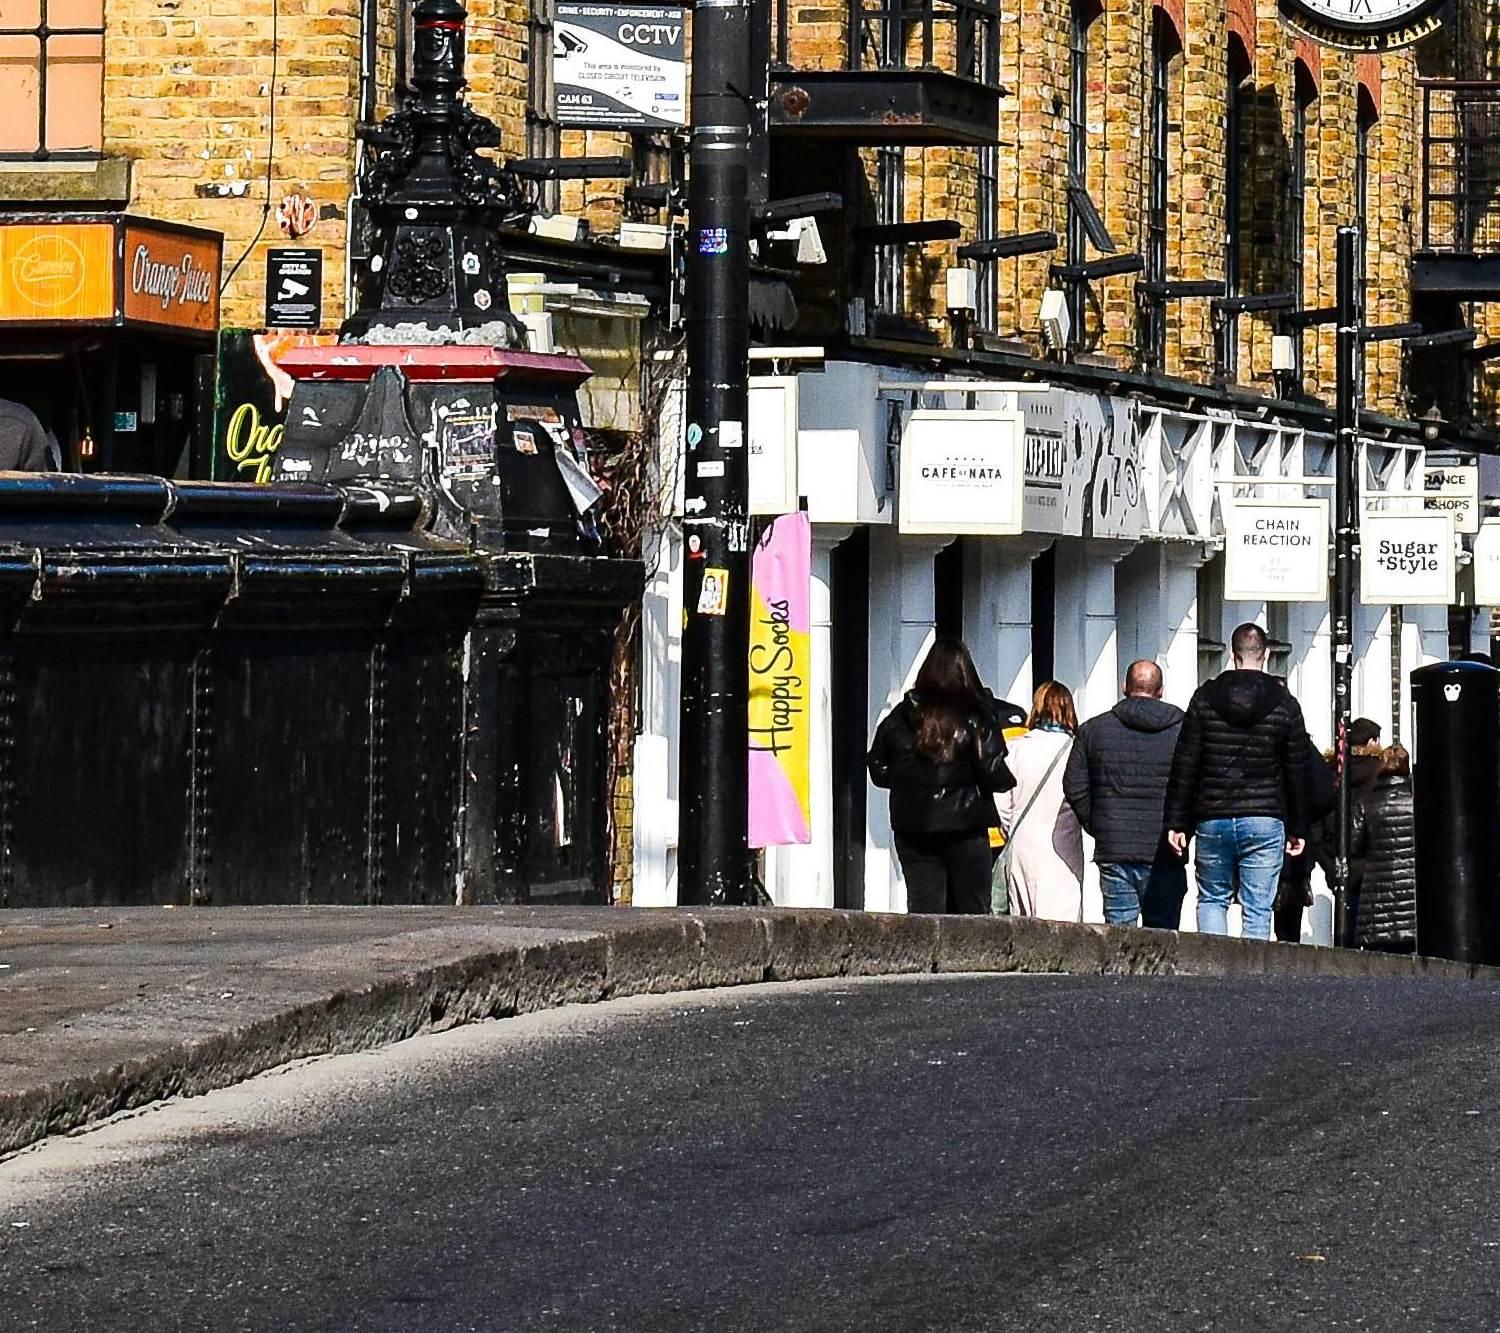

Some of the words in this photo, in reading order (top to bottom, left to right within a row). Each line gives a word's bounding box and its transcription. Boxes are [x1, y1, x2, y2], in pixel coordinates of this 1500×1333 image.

[617, 23, 682, 46] CCTV
[1386, 15, 1443, 44] HALL
[557, 94, 579, 105] CAM
[131, 243, 179, 310] Orange
[176, 252, 213, 306] Juice
[969, 467, 1002, 480] NATA
[1424, 473, 1466, 485] RANCE
[1255, 519, 1300, 531] CHAIN
[1243, 534, 1311, 546] REACTION
[1379, 540, 1439, 558] Sugar
[1376, 556, 1438, 575] +Style
[749, 598, 793, 675] Socks
[748, 675, 803, 758] Happy
